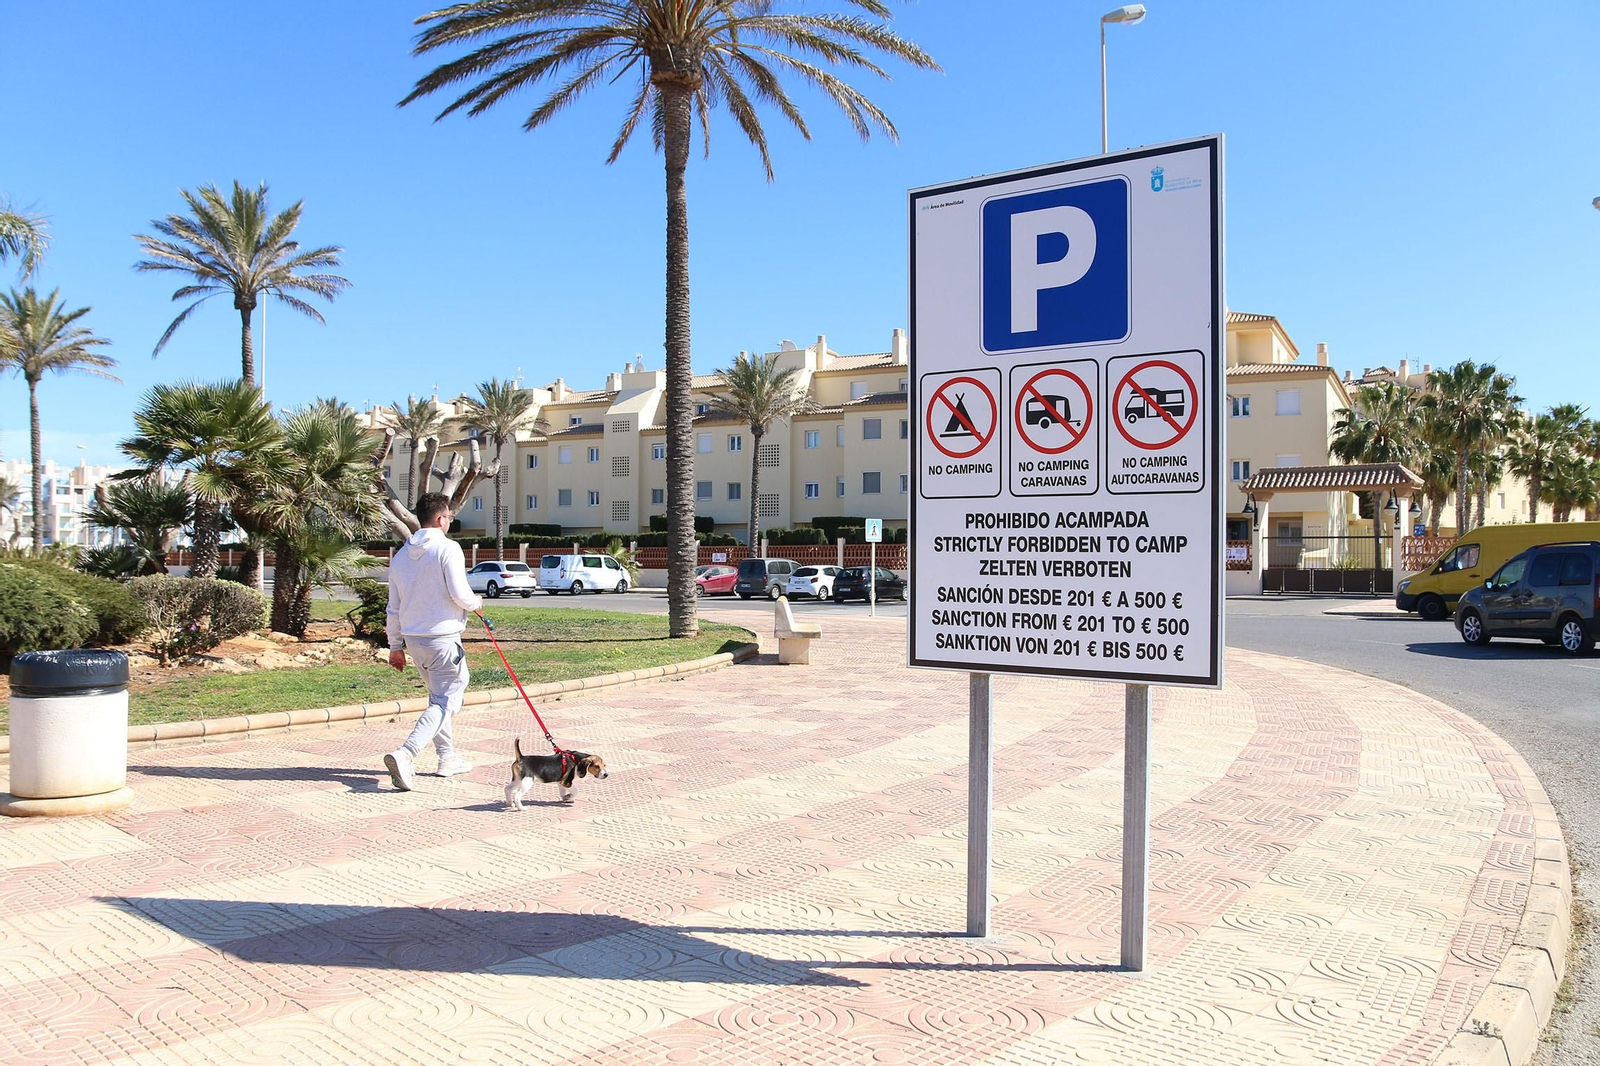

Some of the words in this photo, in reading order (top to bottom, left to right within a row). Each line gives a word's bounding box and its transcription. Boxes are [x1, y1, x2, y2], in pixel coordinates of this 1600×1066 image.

[1011, 205, 1097, 333] P
[929, 466, 942, 475] NO
[946, 464, 992, 474] CAMPING
[1019, 462, 1033, 472] NO
[1038, 460, 1089, 471] CAMPING
[1123, 458, 1136, 468] NO
[1140, 456, 1187, 467] CAMPING
[1021, 475, 1086, 487] CARAVANAS
[1111, 472, 1199, 484] AUTOCARAVANAS
[966, 512, 1050, 529] PROHIBIDO
[1055, 511, 1149, 528] ACAMPADA
[934, 537, 1003, 552] STRICTLY
[1008, 536, 1100, 552] FORBIDDEN
[1107, 536, 1129, 553] TO
[1136, 536, 1187, 553] CAMP
[980, 560, 1036, 576] ZELTEN
[1042, 561, 1131, 577] VERBOTEN
[938, 584, 1003, 603] SANCIÓN
[1009, 589, 1061, 605] DESDE
[1068, 590, 1093, 606] 201
[1102, 591, 1111, 607] €
[1117, 591, 1129, 607] A
[1135, 592, 1165, 608] 500
[1172, 593, 1182, 609] €
[932, 610, 1006, 628] SANCTION
[1013, 613, 1056, 630] FROM
[1063, 615, 1072, 630] €
[1078, 615, 1104, 632] 201
[1112, 616, 1135, 633] TO
[1141, 618, 1151, 634] €
[1157, 618, 1189, 635] 500
[936, 633, 1010, 652] SANKTION
[1016, 637, 1047, 654] VON
[1054, 639, 1079, 656] 201
[1087, 641, 1096, 656] €
[1103, 641, 1130, 658] BIS
[1136, 643, 1167, 660] 500
[1174, 645, 1183, 661] €
